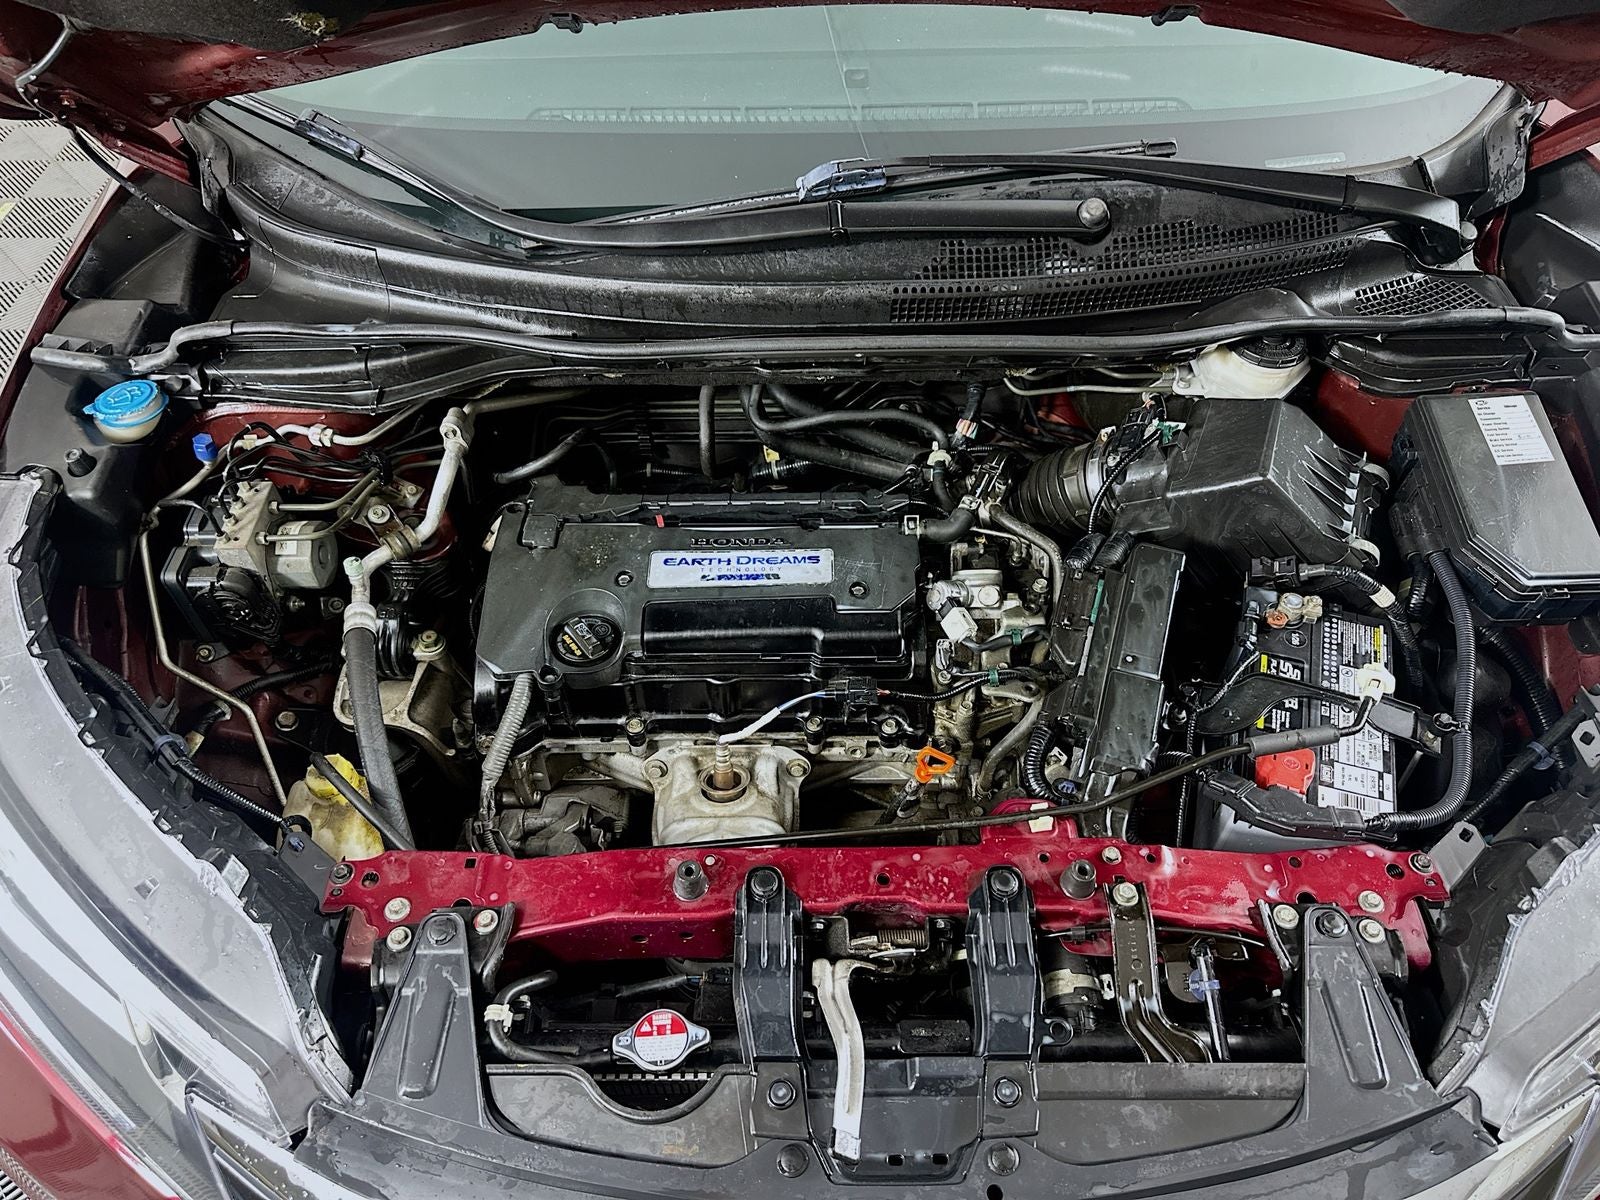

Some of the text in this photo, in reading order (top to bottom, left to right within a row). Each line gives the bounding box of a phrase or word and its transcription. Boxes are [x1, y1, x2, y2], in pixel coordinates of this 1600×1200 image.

[690, 537, 791, 547] HONDA
[663, 555, 821, 566] EARTH DREAMS
